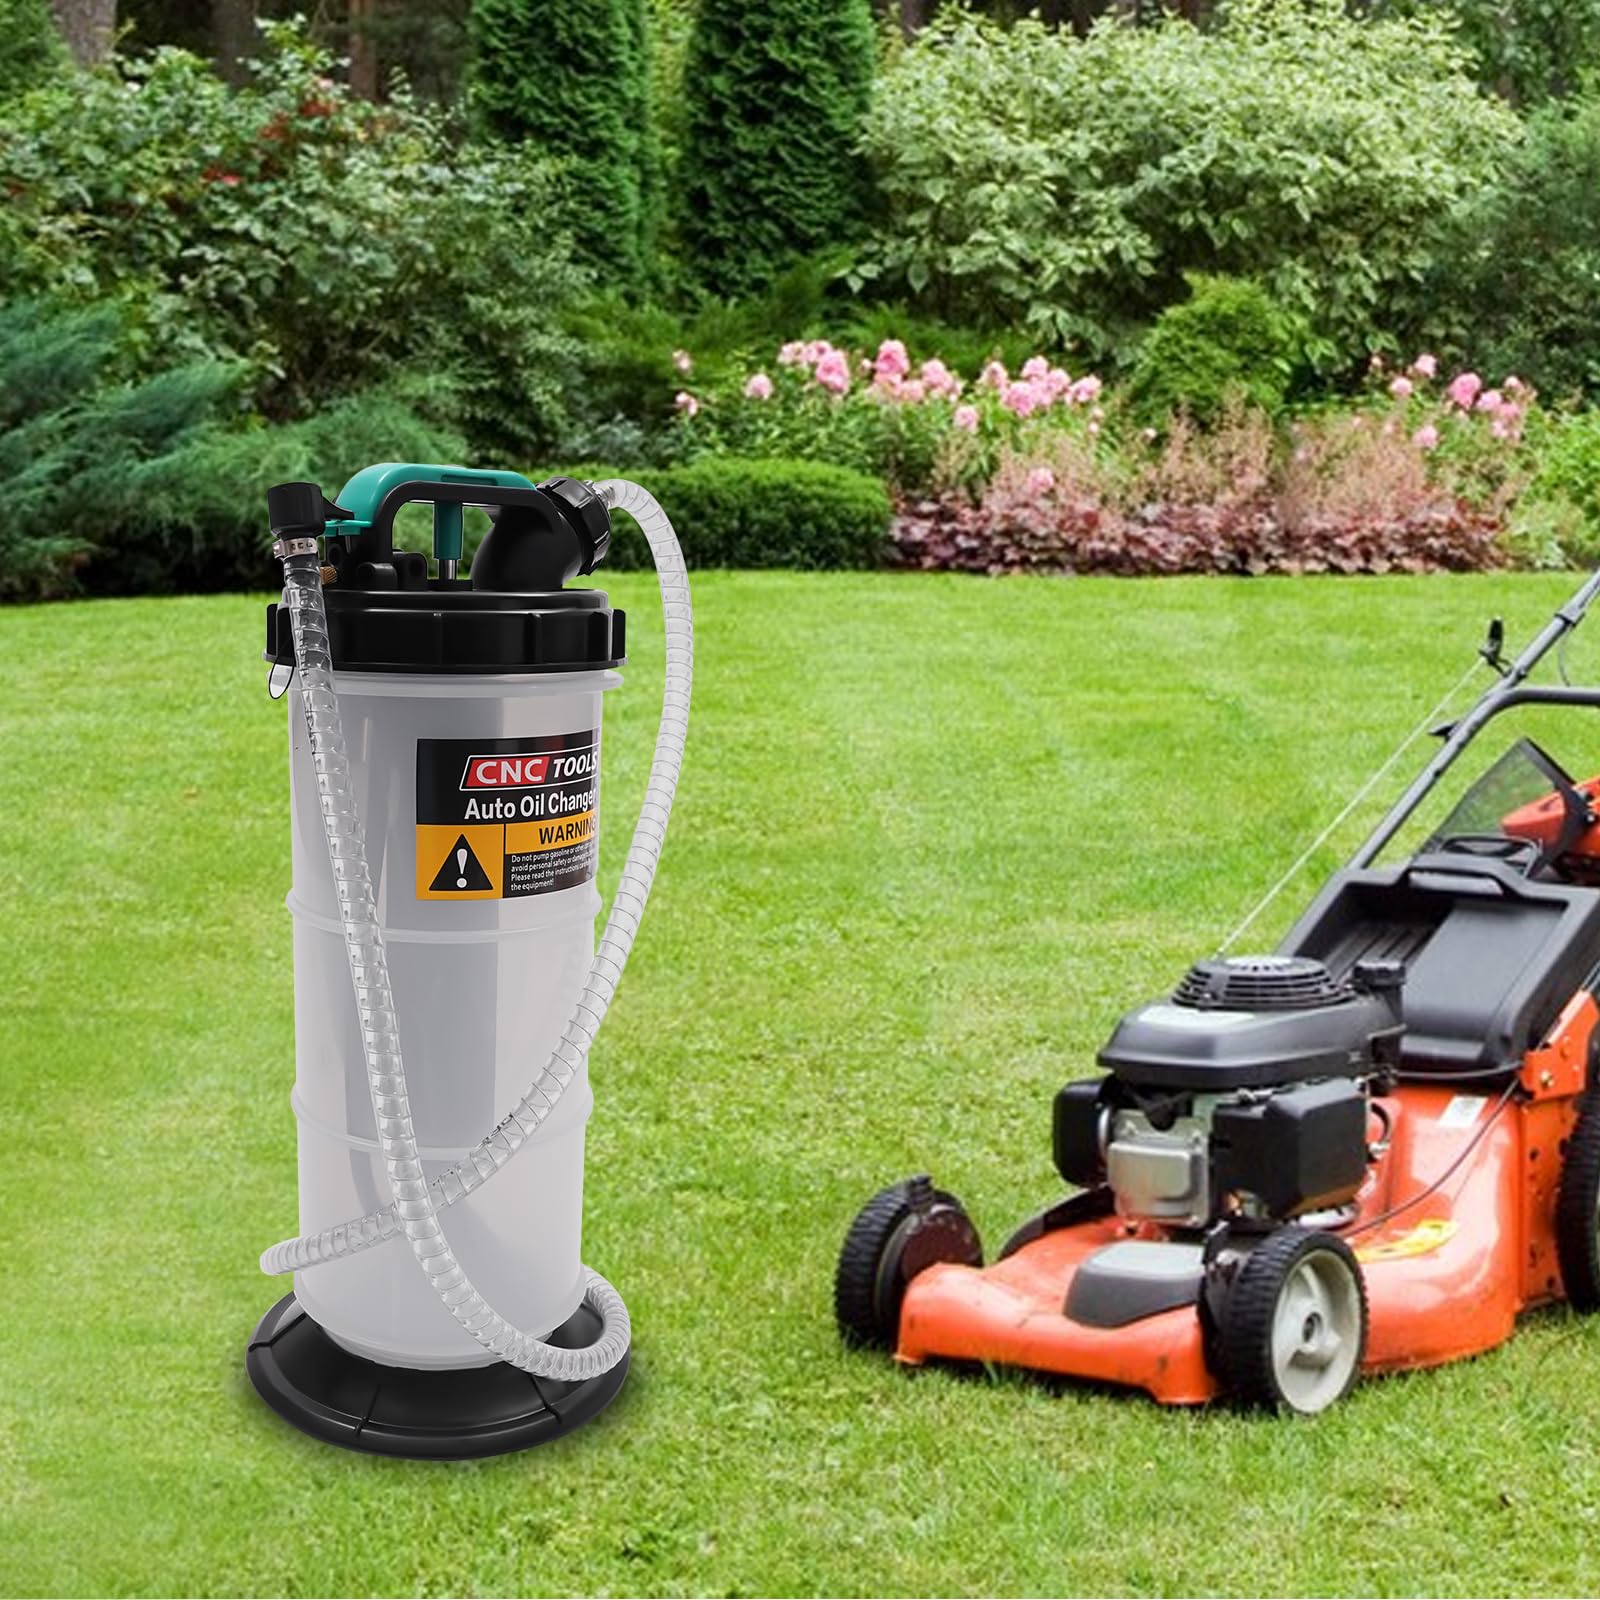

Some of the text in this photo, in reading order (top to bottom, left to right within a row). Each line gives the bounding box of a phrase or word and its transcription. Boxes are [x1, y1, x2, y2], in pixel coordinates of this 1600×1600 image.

[476, 752, 597, 784] CNC TOOLS
[464, 798, 516, 820] Auto
[520, 793, 545, 817] Oil
[511, 855, 521, 863] Do
[522, 854, 532, 862] not
[533, 852, 549, 862] pump
[550, 848, 569, 859] gasoline
[511, 863, 528, 872] avoid
[529, 860, 552, 872] personal
[553, 857, 566, 867] safety
[511, 873, 531, 881] Please
[532, 870, 544, 879] read
[545, 869, 554, 877] the
[511, 883, 521, 891] the
